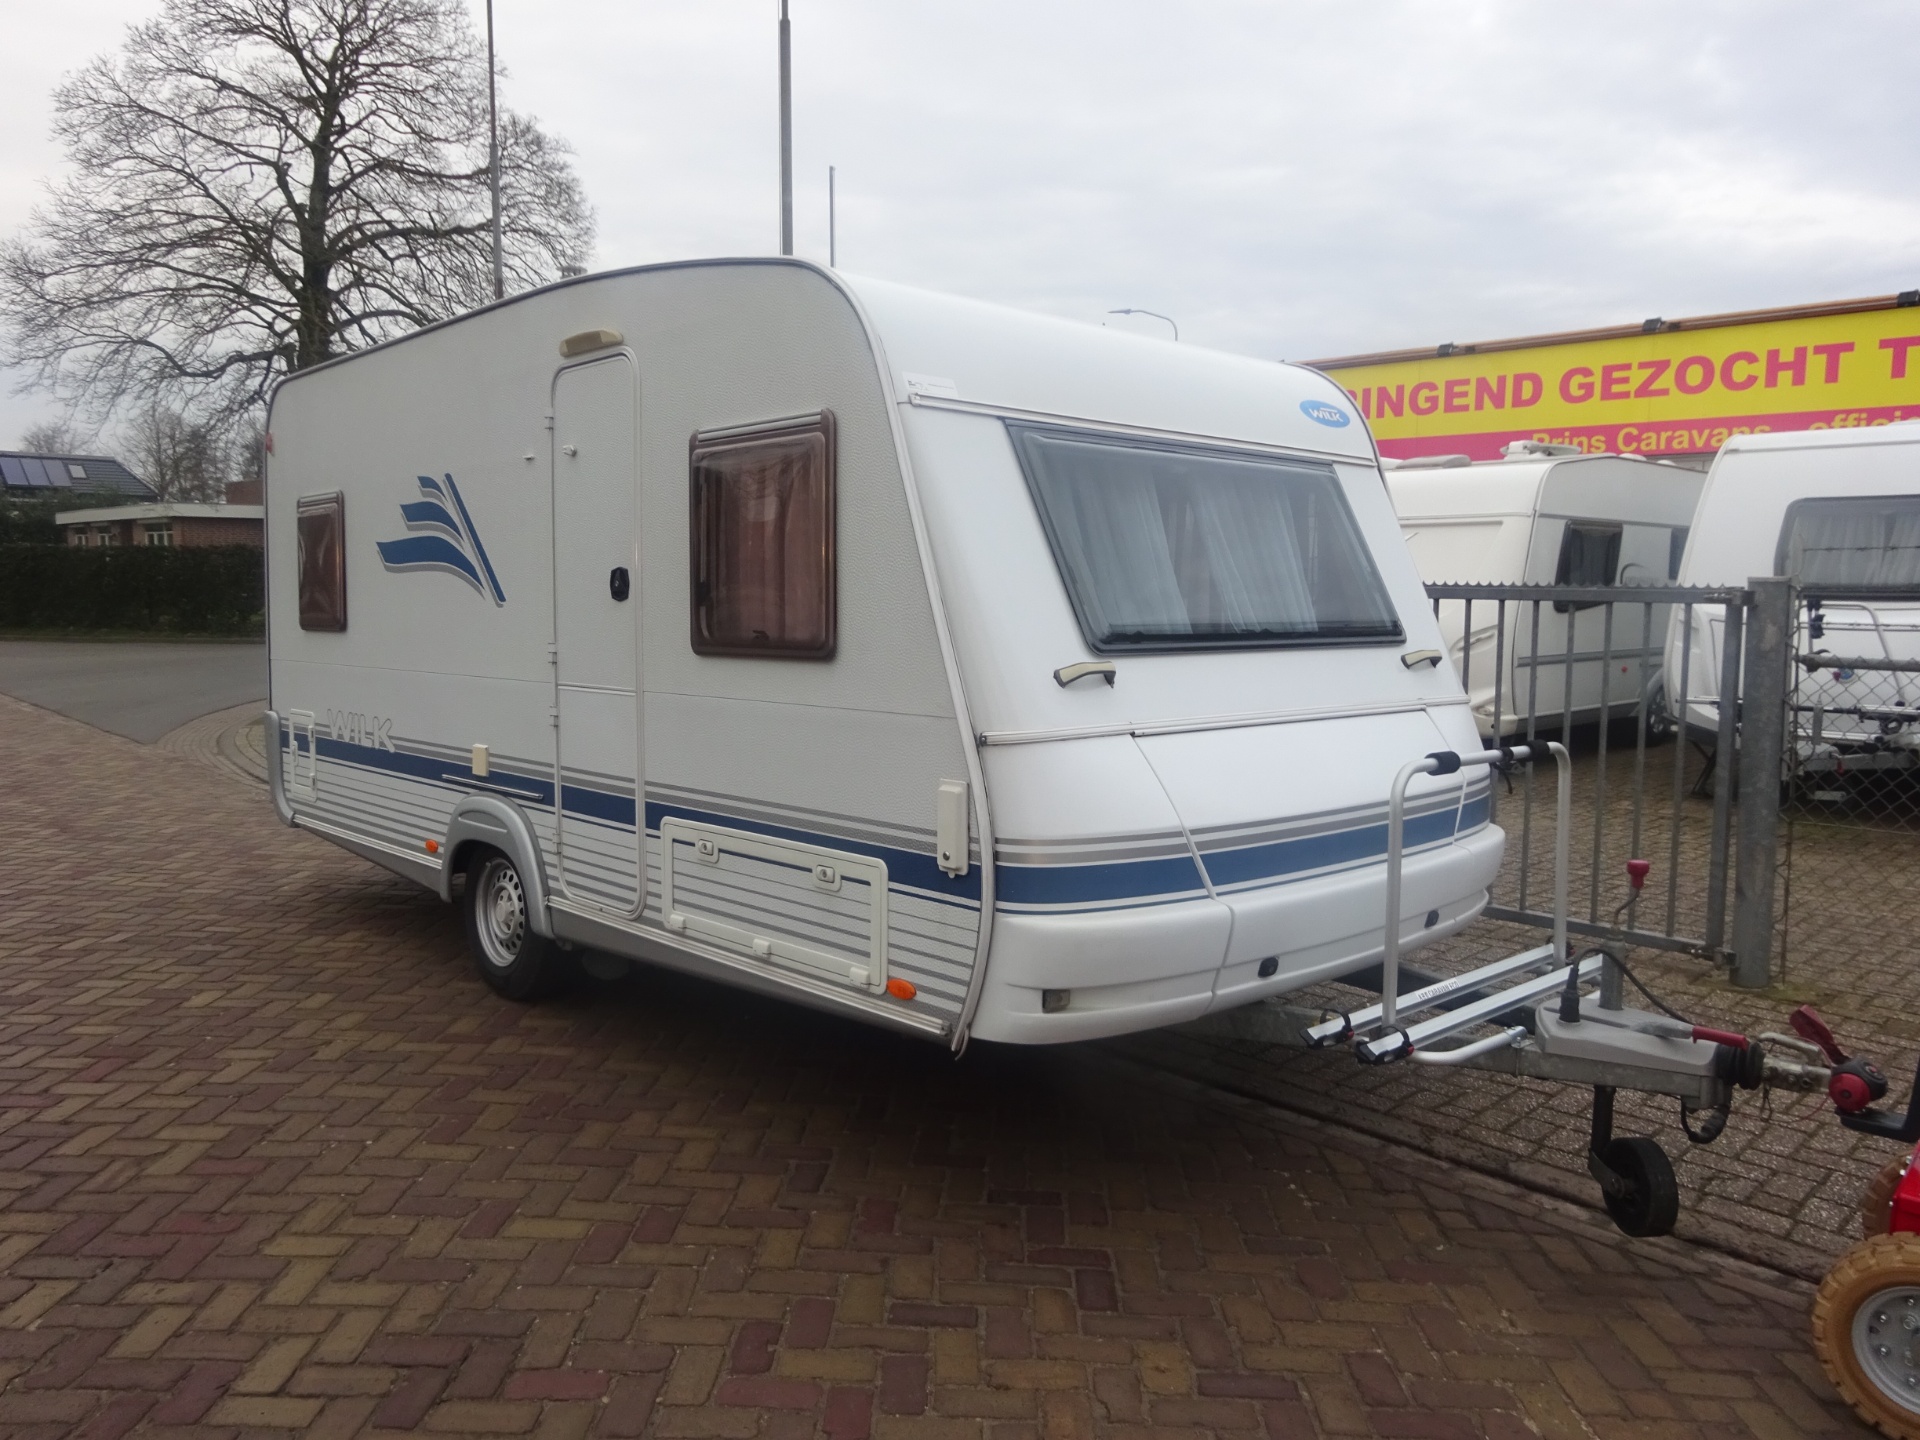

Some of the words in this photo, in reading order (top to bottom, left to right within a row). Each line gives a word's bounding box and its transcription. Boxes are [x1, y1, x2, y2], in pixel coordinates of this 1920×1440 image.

[1347, 372, 1543, 420] INGEND
[1559, 341, 1856, 404] GEZOCHT
[1309, 407, 1344, 422] WILK
[326, 708, 396, 753] WILK
